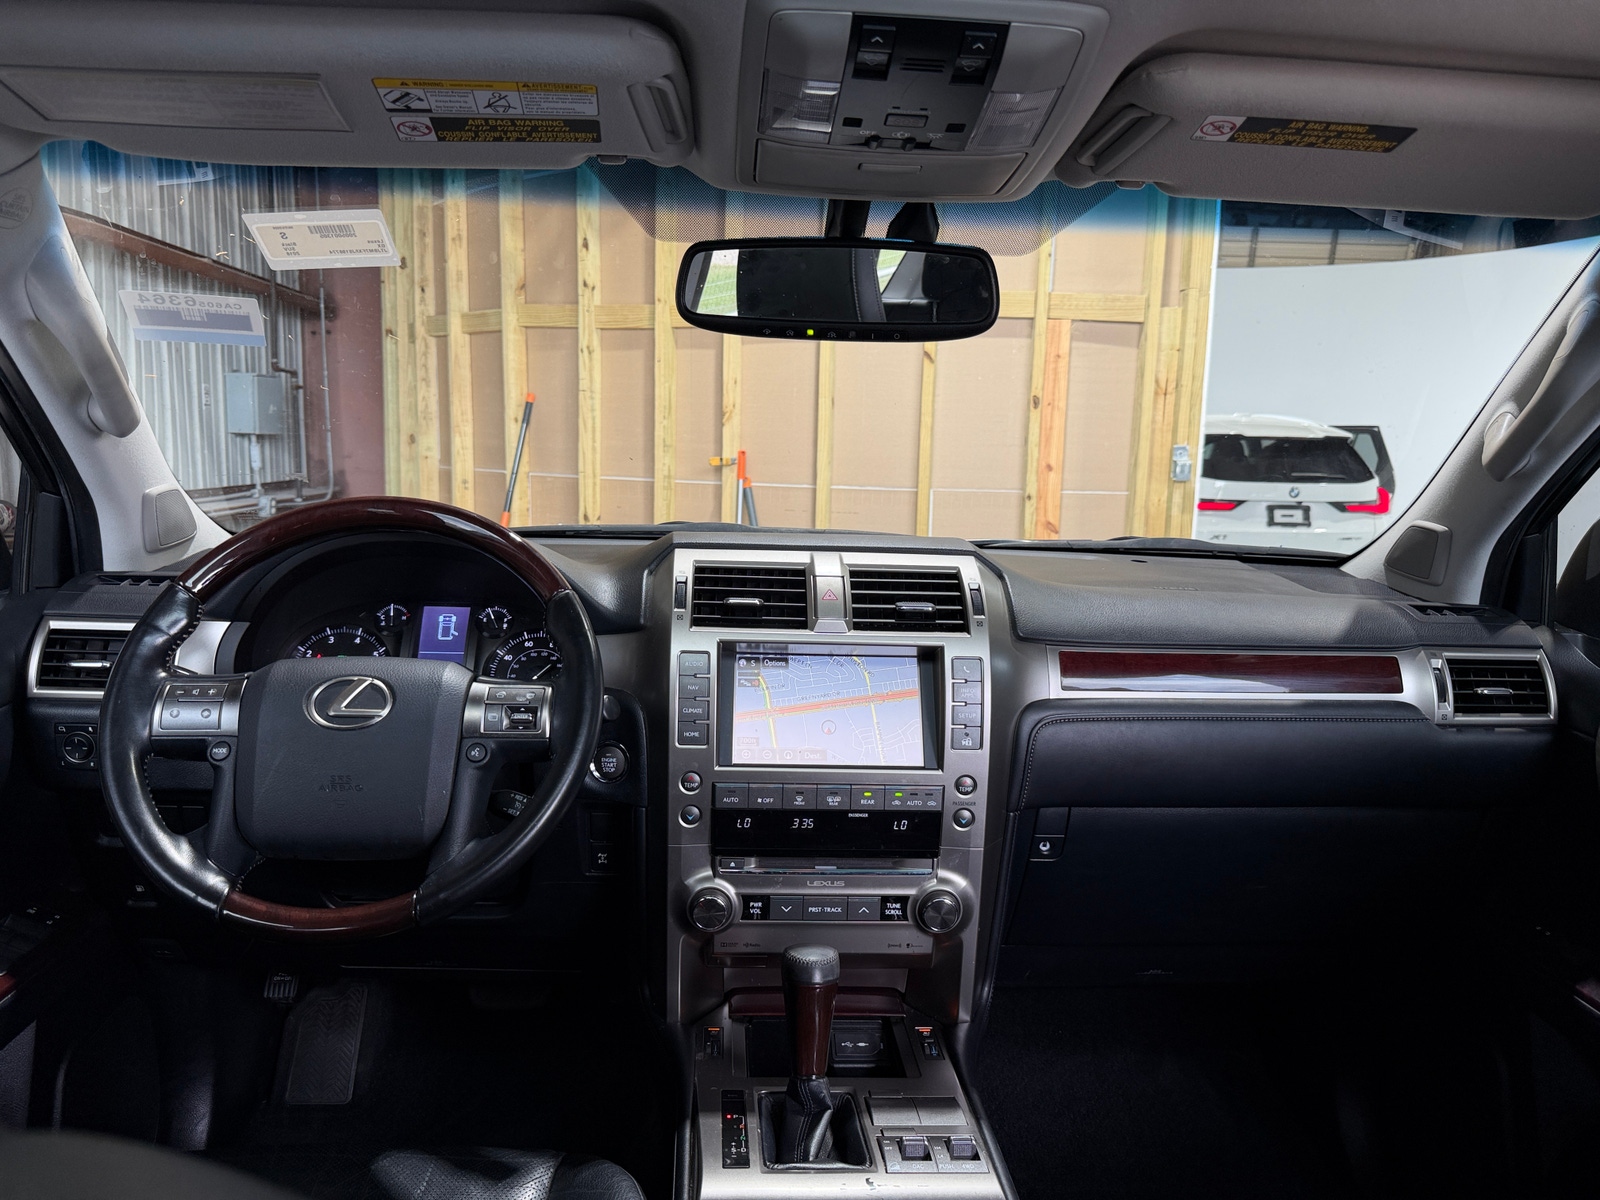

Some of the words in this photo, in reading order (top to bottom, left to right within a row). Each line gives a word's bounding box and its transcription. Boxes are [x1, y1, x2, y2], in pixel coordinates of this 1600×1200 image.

[1288, 121, 1305, 129] AIR
[1305, 122, 1326, 130] BAG
[1328, 123, 1369, 133] WARNING
[1233, 131, 1272, 140] COUSSIN
[1273, 135, 1326, 144] GONFLABLE
[1326, 138, 1398, 149] AVERTISSEMENT
[328, 636, 335, 644] 3
[354, 636, 361, 644] 4
[524, 640, 534, 648] 60
[305, 649, 313, 658] 2
[764, 659, 787, 668] Options
[330, 774, 353, 783] SRS
[318, 784, 364, 792] AIRBAG
[806, 880, 846, 888] LEXUS
